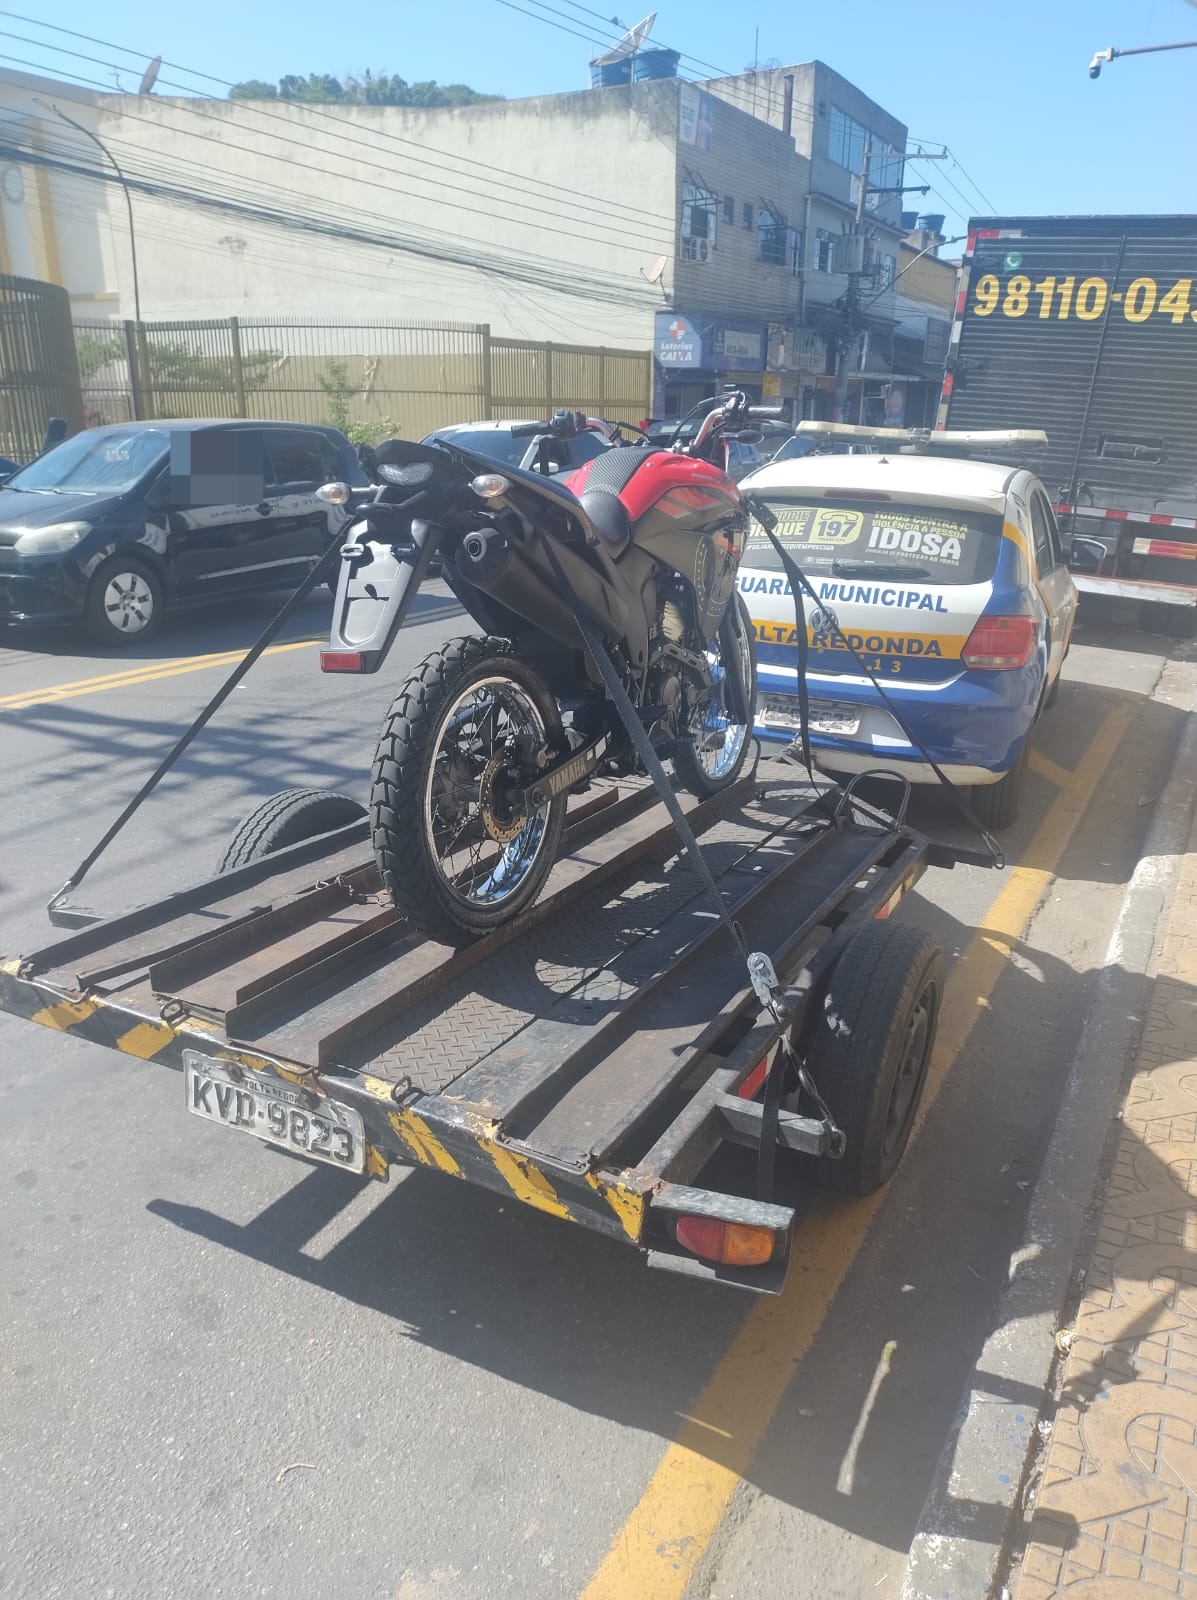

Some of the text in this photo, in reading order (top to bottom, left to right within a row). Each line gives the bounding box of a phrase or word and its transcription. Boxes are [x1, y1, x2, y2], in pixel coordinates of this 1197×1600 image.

[972, 274, 1197, 324] 98110-04
[660, 341, 693, 350] Loterias
[660, 351, 693, 361] CAIXA
[817, 520, 857, 537] 197
[874, 511, 909, 521] TODOS
[912, 514, 958, 530] CONTRA
[929, 526, 966, 540] PESSOA
[868, 527, 961, 560] IDOSA
[819, 582, 949, 613] MUNICIPAL
[752, 624, 942, 656] LTA REDONDA
[549, 757, 587, 795] YAMAHA
